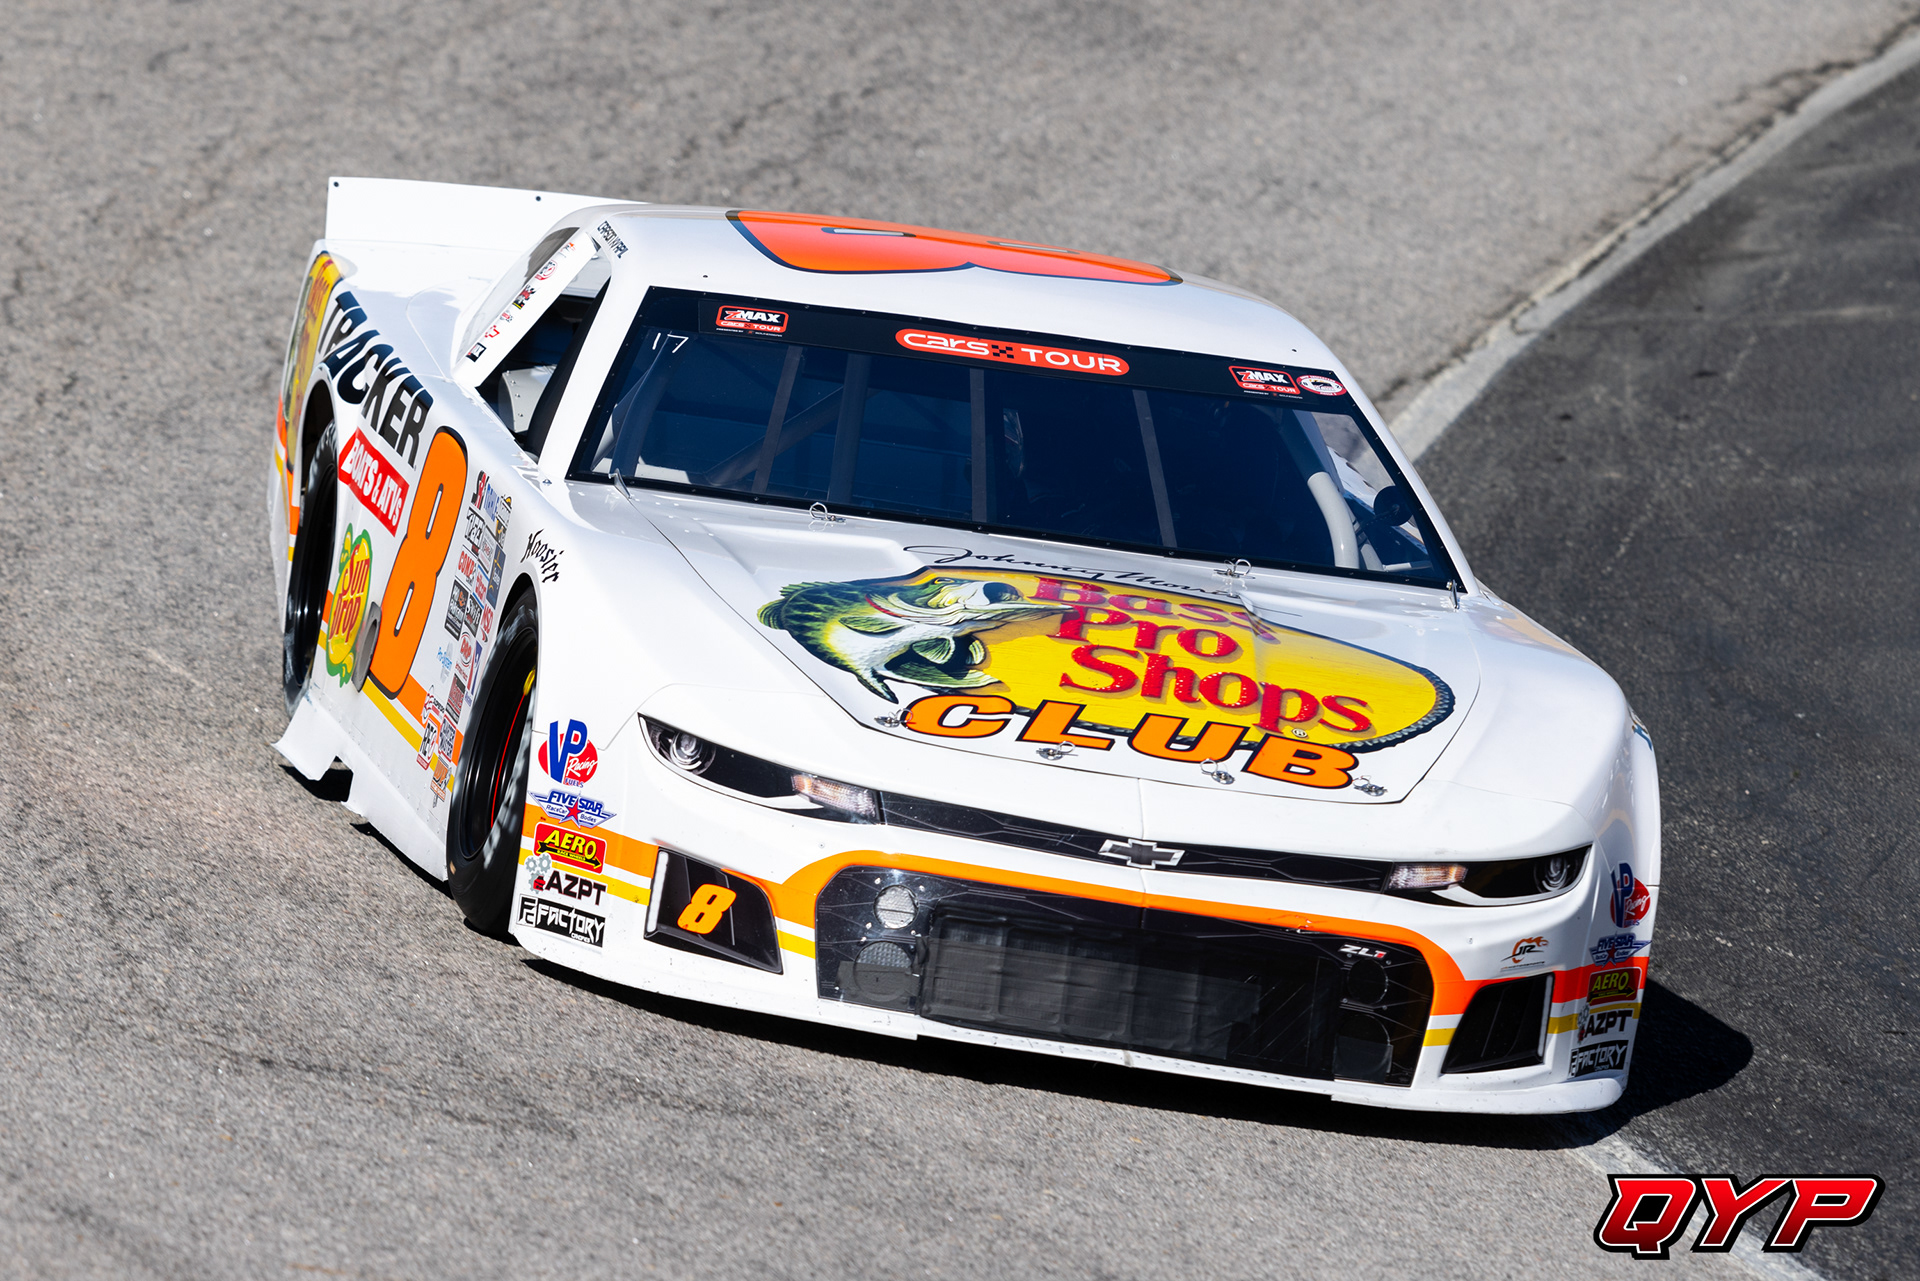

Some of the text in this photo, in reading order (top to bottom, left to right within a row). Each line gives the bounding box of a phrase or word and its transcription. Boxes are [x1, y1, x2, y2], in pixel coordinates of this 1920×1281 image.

[752, 323, 781, 332] TOUR
[318, 291, 434, 471] TRACKER
[1020, 347, 1122, 373] TOUR
[1270, 386, 1297, 394] TOUR
[340, 437, 379, 497] BOATS
[371, 472, 382, 505] &
[341, 543, 370, 599] Sun
[375, 425, 468, 699] 8
[519, 527, 565, 583] Hoosier
[328, 592, 362, 645] Drop
[1026, 577, 1282, 645] Bass
[1050, 603, 1242, 657] Pro
[1058, 644, 1374, 734] Shops
[549, 719, 588, 784] VP
[566, 757, 599, 777] Racing
[904, 694, 1359, 789] CLUB
[549, 791, 603, 815] FIVE STAR
[544, 830, 597, 860] AERO
[545, 870, 607, 906] AZPT
[677, 883, 737, 935] 8
[1611, 862, 1634, 928] VP
[1340, 944, 1387, 958] ZL1
[1592, 972, 1630, 991] AERO
[1584, 1009, 1633, 1038] AZPT
